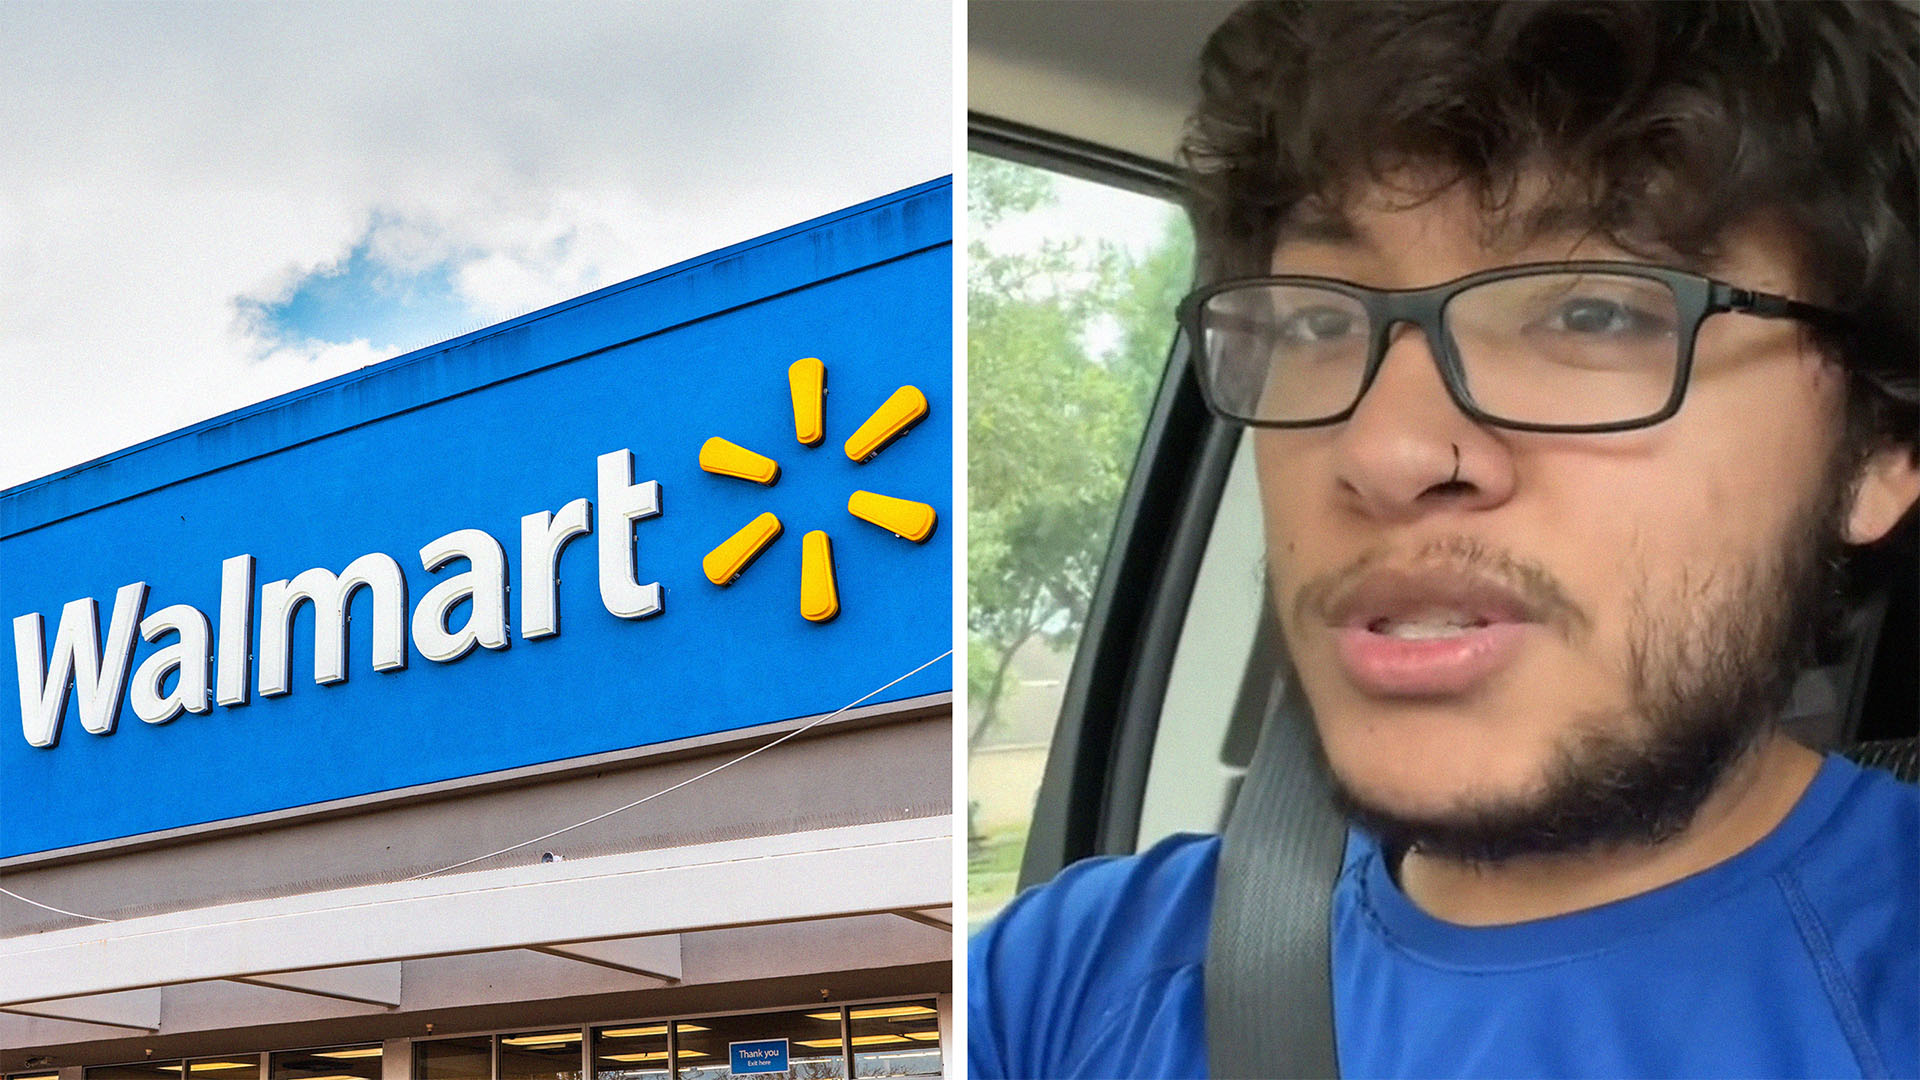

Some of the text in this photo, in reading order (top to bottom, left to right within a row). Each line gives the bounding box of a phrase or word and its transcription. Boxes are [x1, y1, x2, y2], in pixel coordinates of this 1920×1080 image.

[13, 448, 663, 748] Walmart
[739, 1048, 779, 1058] Thank you
